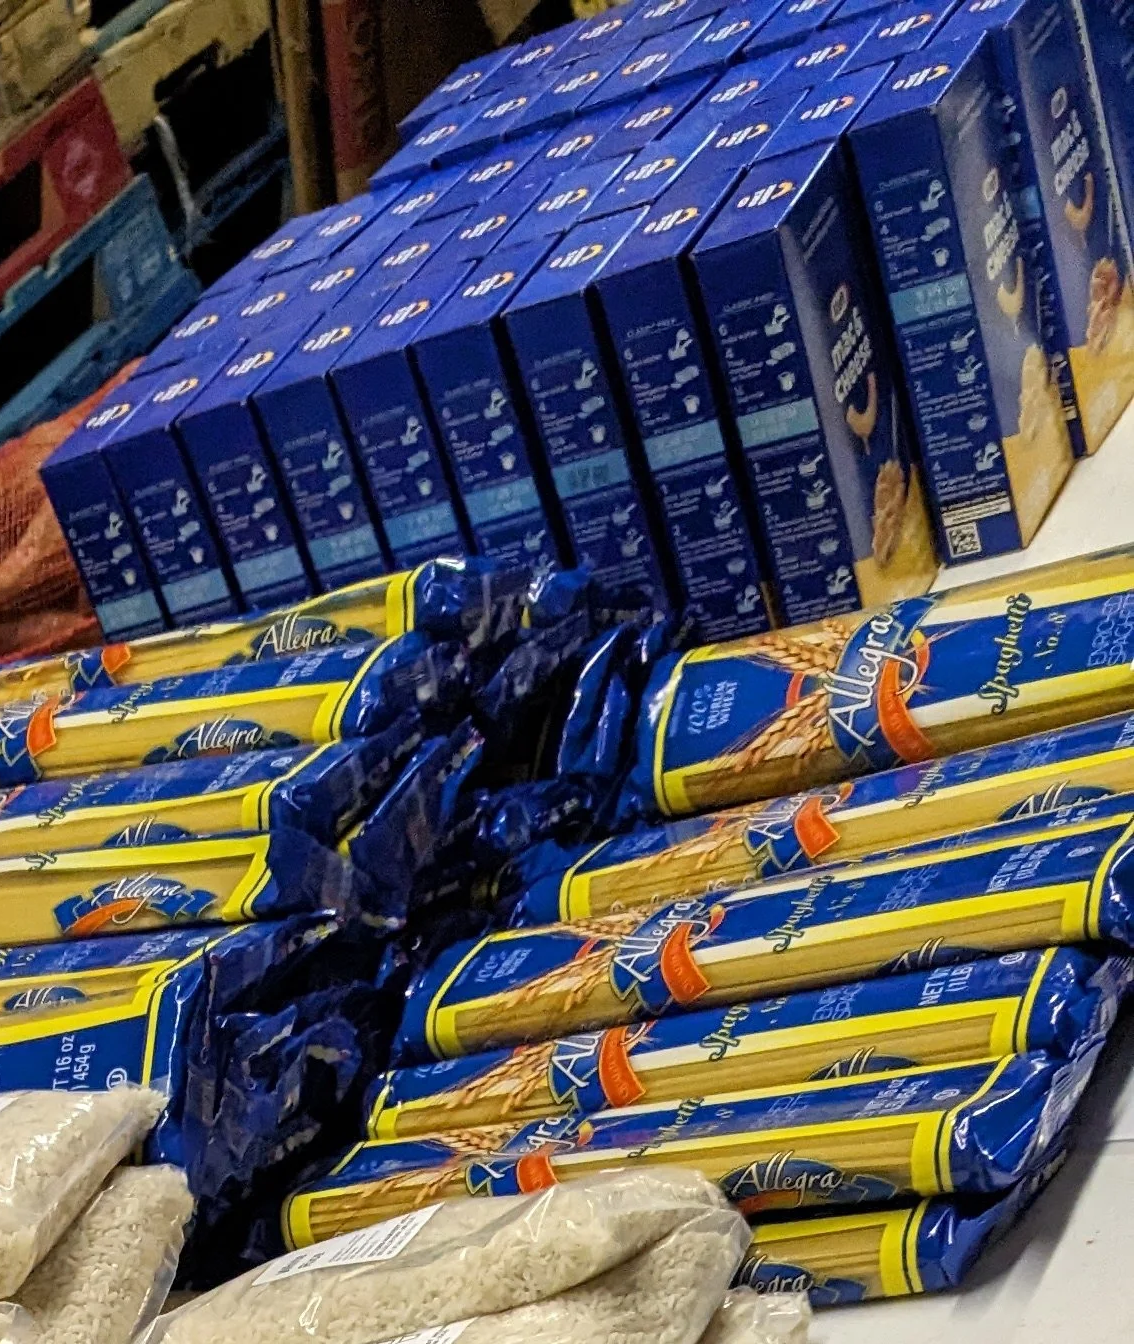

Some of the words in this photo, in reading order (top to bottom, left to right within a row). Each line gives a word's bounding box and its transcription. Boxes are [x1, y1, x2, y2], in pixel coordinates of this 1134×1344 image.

[256, 611, 339, 660] Allegra
[977, 593, 1032, 715] Spaghetti
[823, 613, 919, 747] Allegra
[179, 713, 263, 757] Allegra
[91, 873, 182, 924] Allegra
[613, 899, 710, 983] Allegra
[56, 1056, 71, 1070] 16
[61, 1034, 75, 1052] oz
[72, 1043, 96, 1082] 454g
[735, 1150, 843, 1206] Allegra
